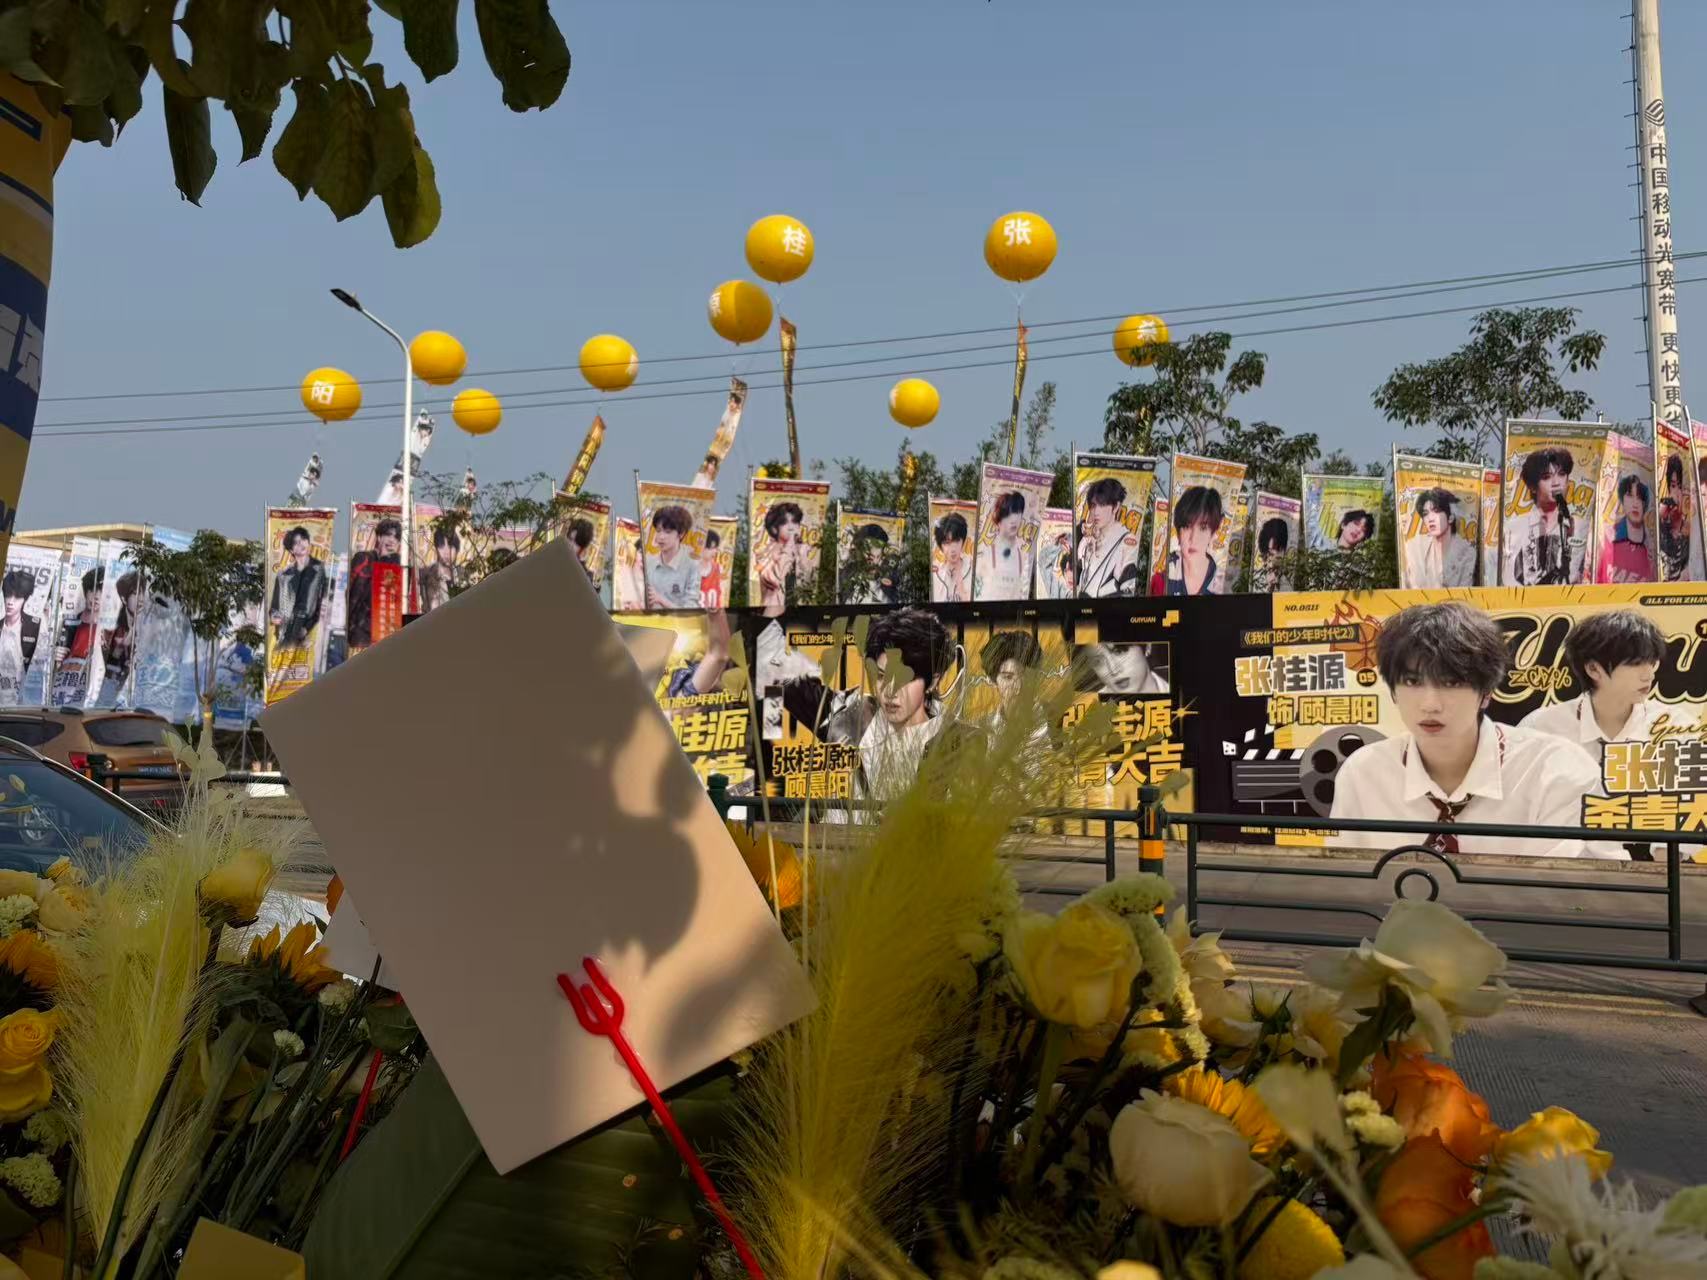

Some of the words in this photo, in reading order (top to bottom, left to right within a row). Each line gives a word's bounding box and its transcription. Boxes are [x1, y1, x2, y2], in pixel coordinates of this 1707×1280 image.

[782, 226, 808, 256] 桂
[1003, 219, 1032, 245] 张
[1650, 142, 1677, 316] 中国移动光宽带
[310, 380, 335, 405] 阳
[1663, 597, 1682, 605] FOR
[1130, 616, 1157, 624] GUIYUAN
[1243, 627, 1356, 646] 《我们的少年时代2》
[1235, 652, 1346, 697] 张桂源
[1358, 671, 1375, 684] 05
[1298, 694, 1379, 725] 顾晨阳
[771, 742, 861, 777] 张桂源饰
[785, 770, 849, 799] 顾晨阳
